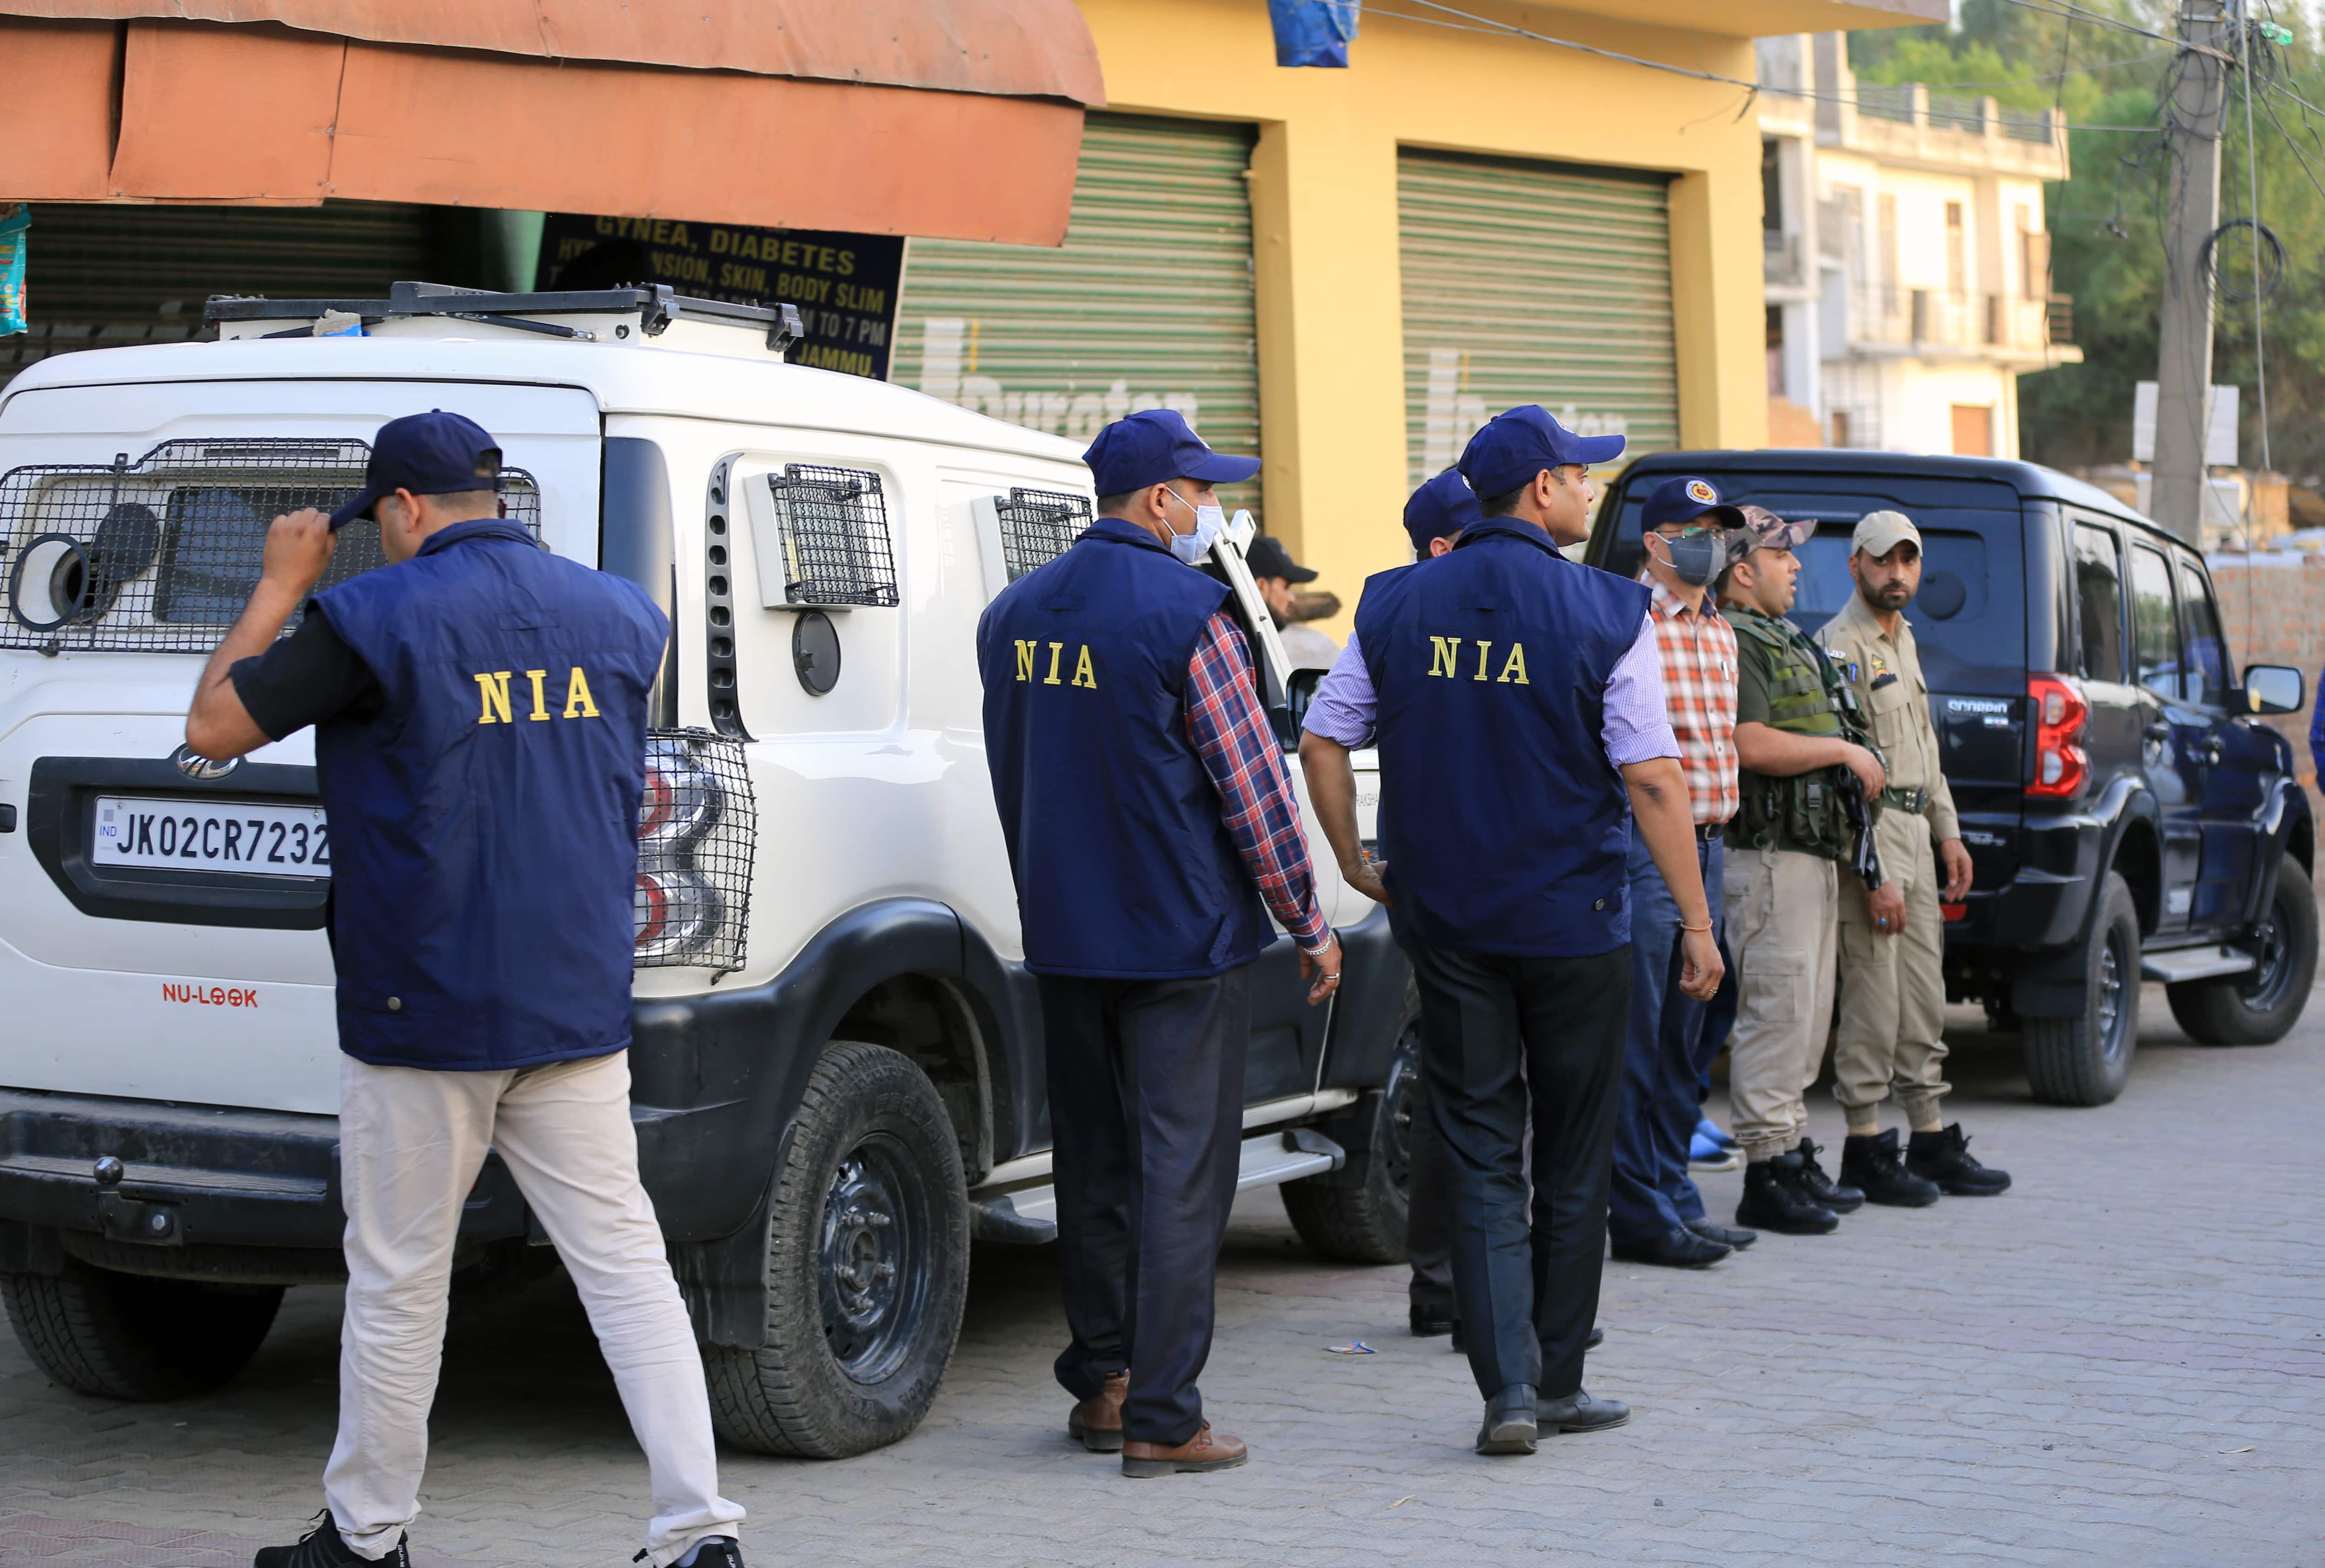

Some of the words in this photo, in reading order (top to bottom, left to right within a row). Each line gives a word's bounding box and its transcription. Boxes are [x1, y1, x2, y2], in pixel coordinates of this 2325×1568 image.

[595, 217, 699, 253] GYNEA,
[709, 228, 856, 276] DIABETES
[719, 261, 771, 297] SKIN,
[776, 271, 831, 304] BODY
[834, 282, 886, 314] SLIM
[819, 311, 841, 338] TO
[845, 316, 857, 341] 7
[857, 318, 886, 347] PM
[796, 342, 878, 379] JAMMU.
[1014, 640, 1097, 689] NIA
[1427, 636, 1529, 685] NIA
[473, 667, 600, 724] NIA
[100, 826, 117, 837] IND
[117, 814, 330, 865] JK02CR7232
[163, 983, 258, 1008] NU-LOOK
